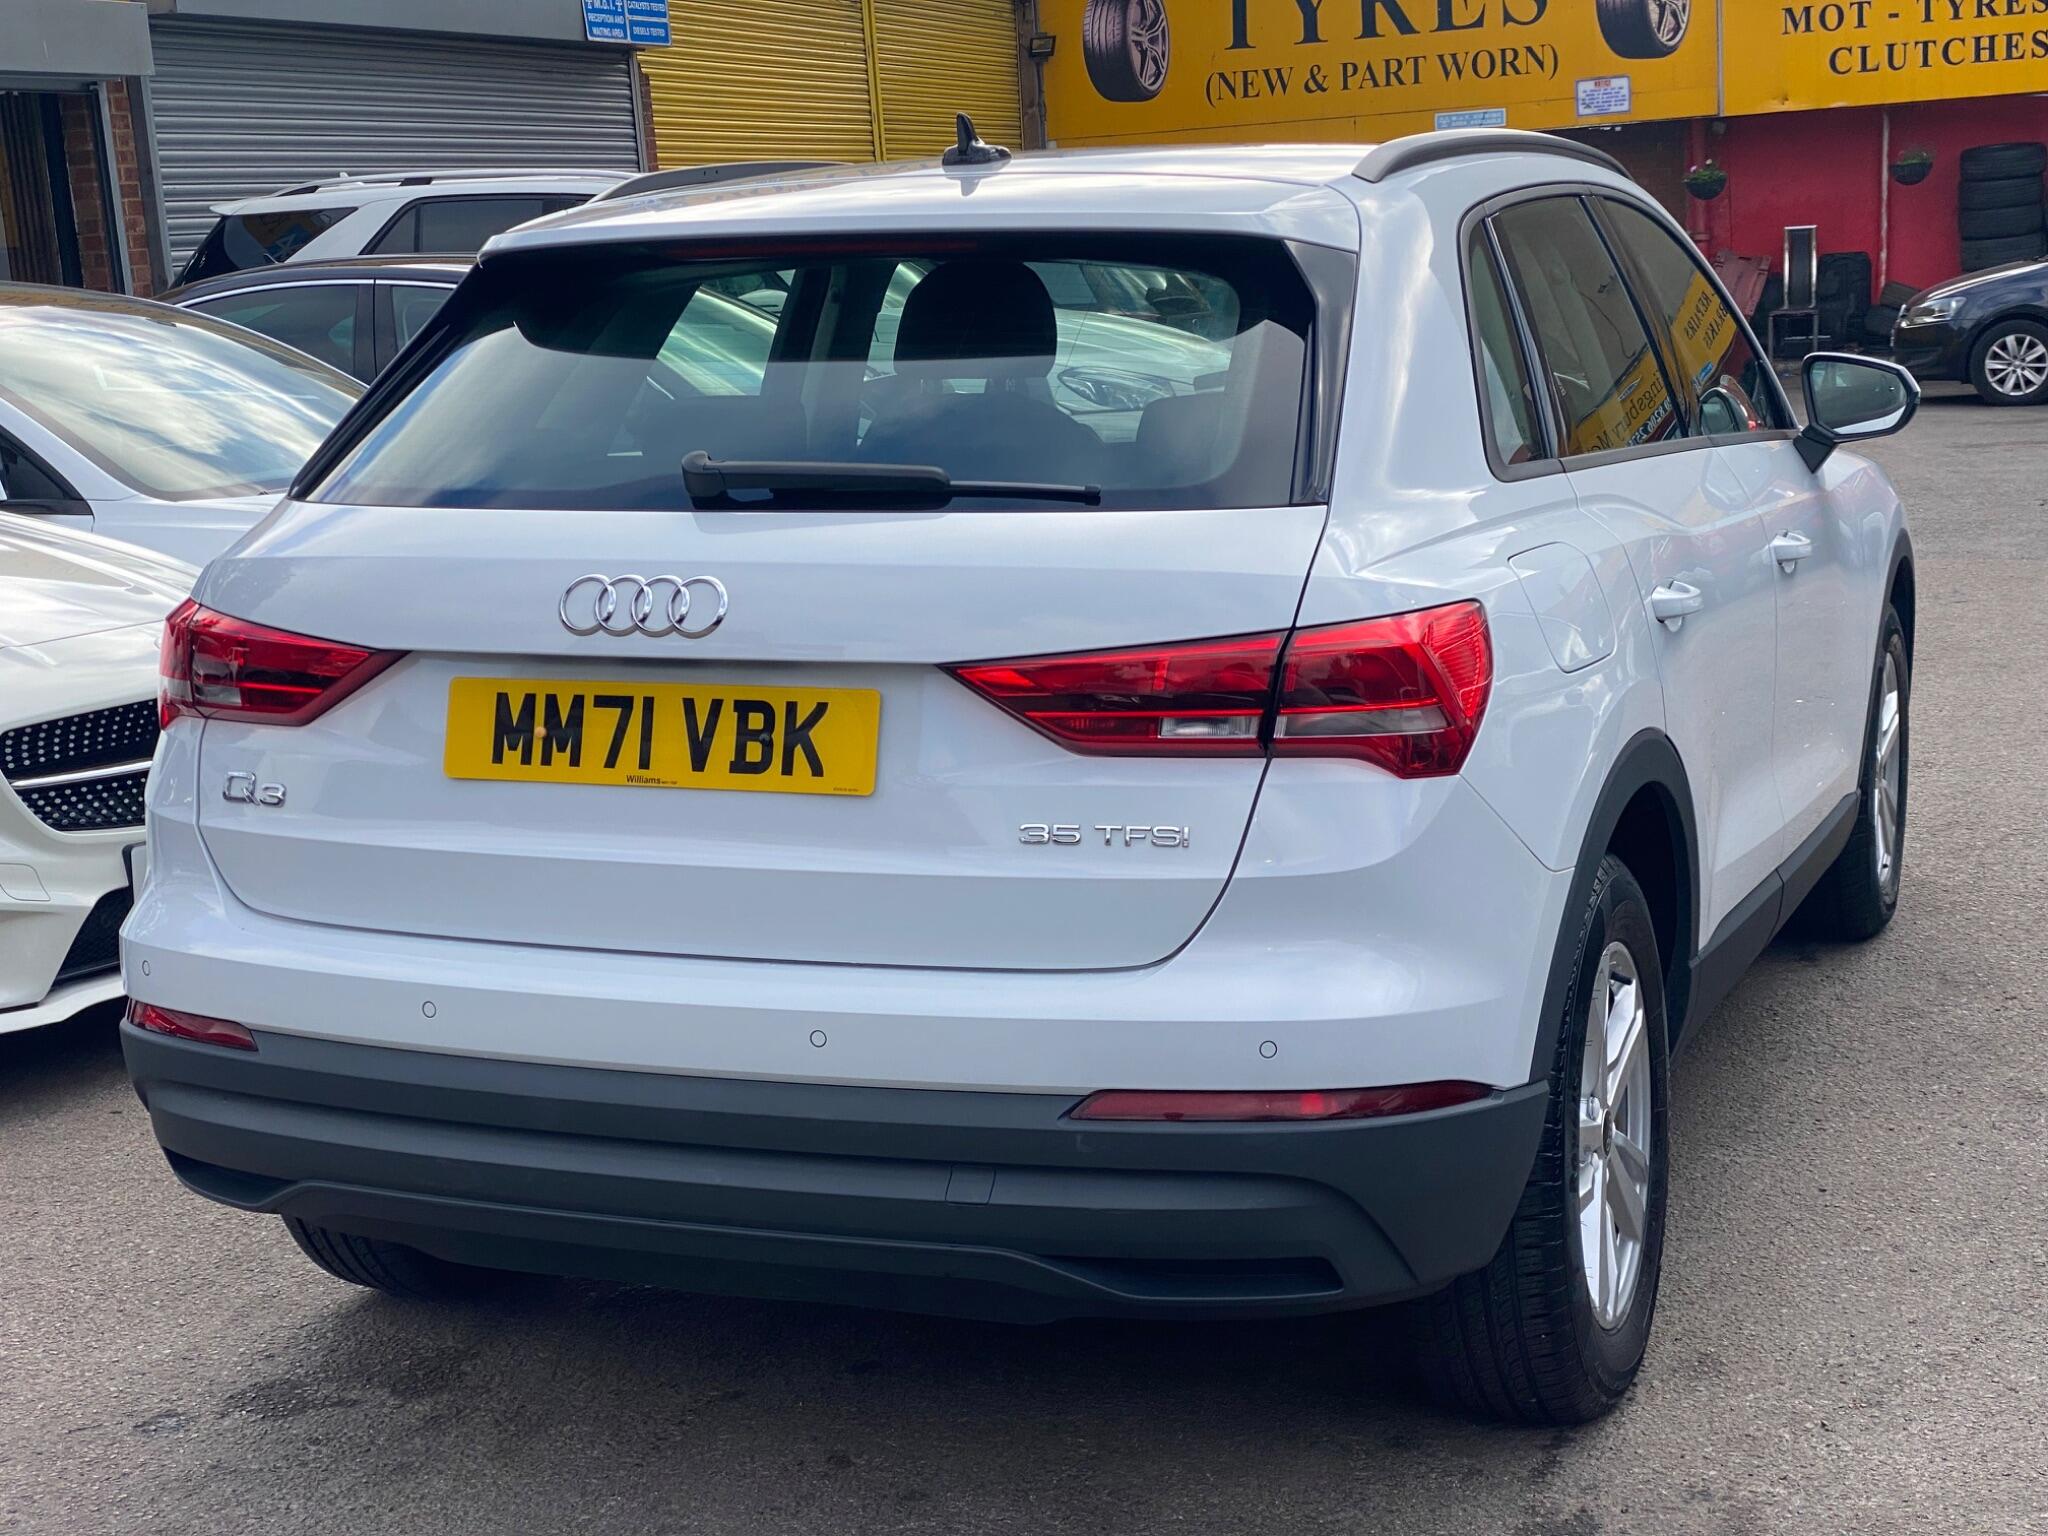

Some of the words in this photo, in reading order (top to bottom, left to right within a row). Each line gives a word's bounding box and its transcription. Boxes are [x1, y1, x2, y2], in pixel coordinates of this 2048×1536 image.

[1781, 1, 1872, 35] MOT
[1829, 29, 2048, 75] CLUTCHES
[1205, 67, 1294, 108] (NEW
[1303, 64, 1329, 93] &
[1340, 56, 1427, 91] PART
[1437, 43, 1559, 81] WORN)
[492, 692, 654, 770] MM71
[682, 697, 829, 777] VBK
[222, 771, 287, 808] Q3
[626, 774, 661, 785] Williams
[1019, 823, 1081, 846] 35
[1094, 824, 1191, 848] TFSI
